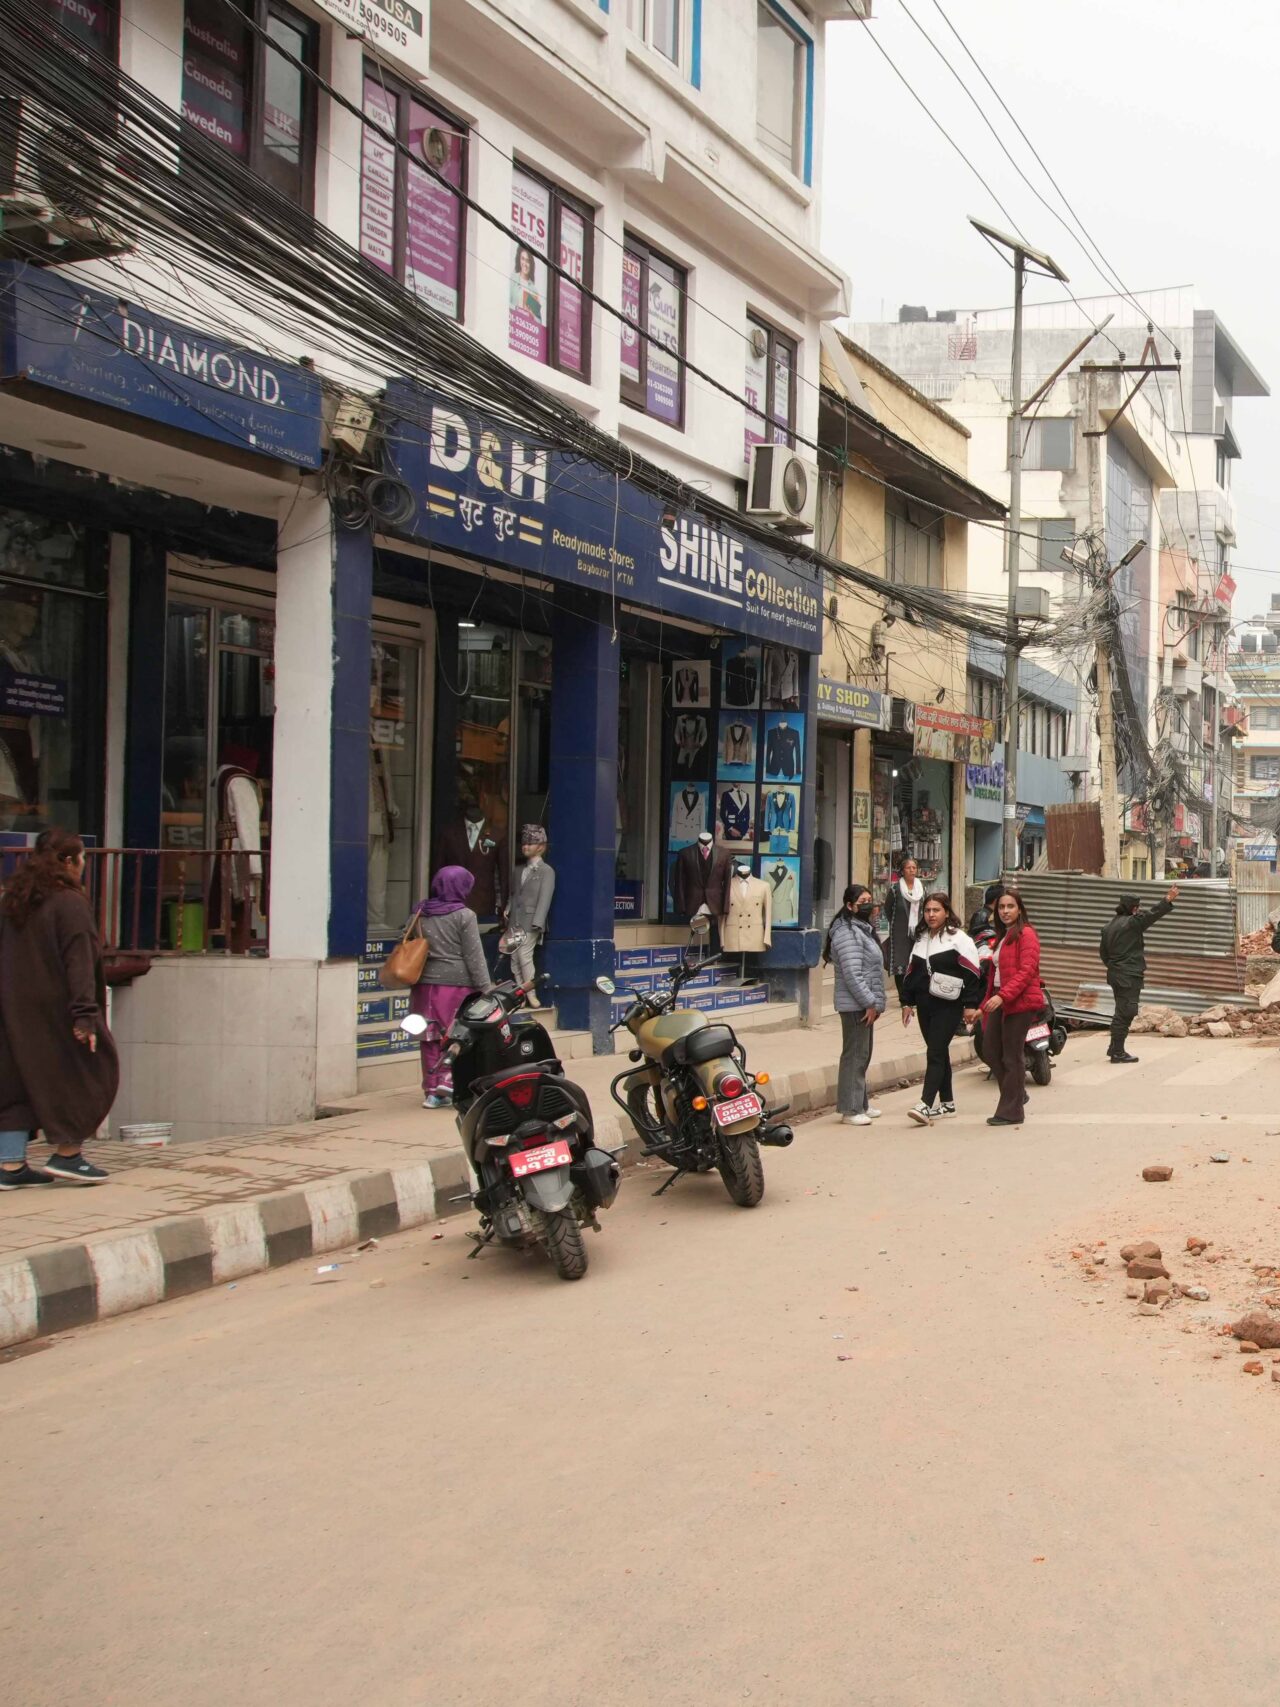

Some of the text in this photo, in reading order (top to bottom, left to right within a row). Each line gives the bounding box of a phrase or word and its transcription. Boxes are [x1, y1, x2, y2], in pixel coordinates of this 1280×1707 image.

[384, 0, 415, 29] USA
[184, 60, 233, 101] Canada
[180, 100, 233, 144] Sweden
[560, 244, 582, 283] PTE
[430, 405, 547, 504] D&H
[552, 529, 635, 570] Readymade Stores
[659, 518, 744, 594] SHINE
[617, 572, 634, 587] KTM
[746, 600, 760, 615] Suit
[771, 611, 786, 625] next
[786, 615, 817, 632] generation
[836, 688, 870, 708] SHOP
